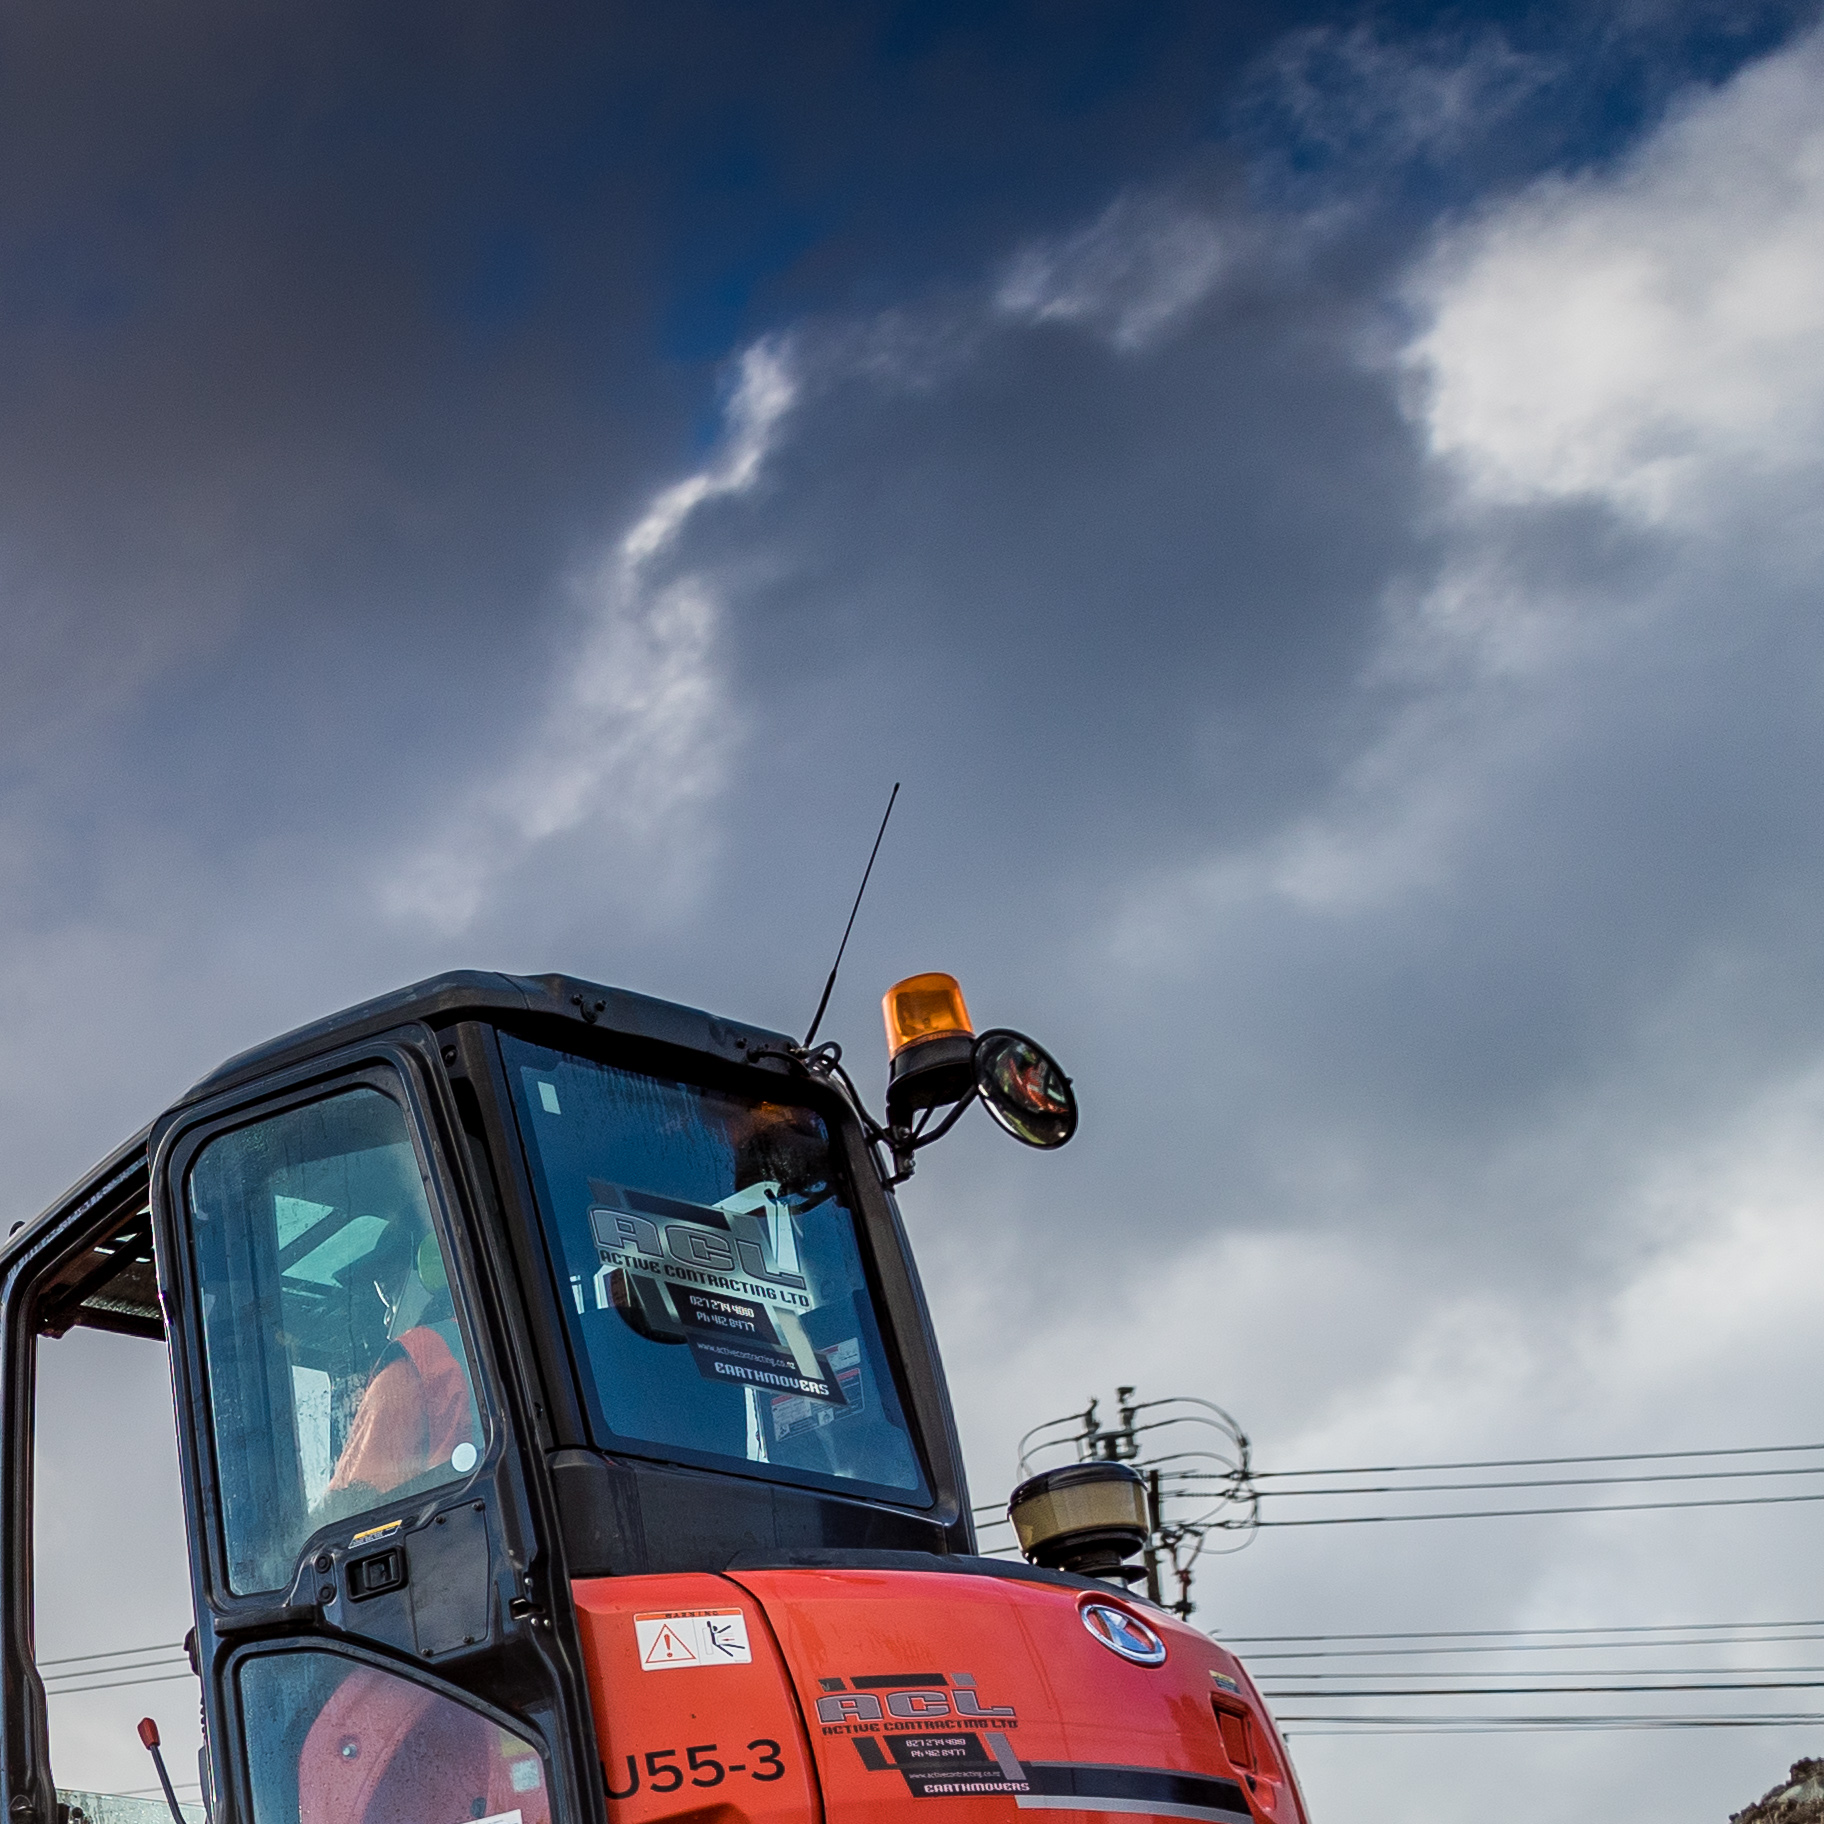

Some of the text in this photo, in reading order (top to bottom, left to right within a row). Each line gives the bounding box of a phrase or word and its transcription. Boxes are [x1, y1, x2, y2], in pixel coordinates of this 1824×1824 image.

[589, 1208, 808, 1291] ACL
[602, 1250, 810, 1307] ACTIVE CONTRACTING LTD
[690, 1295, 710, 1308] 027
[696, 1311, 710, 1323] Ph
[714, 1362, 830, 1396] EARTHMOVERS
[664, 1610, 720, 1619] WARNING
[814, 1689, 1016, 1724] ACL
[822, 1719, 1018, 1735] ACTIVE CONTRACTING LTD
[600, 1738, 786, 1800] U55-3
[923, 1782, 1030, 1794] EARTHMOVERS
